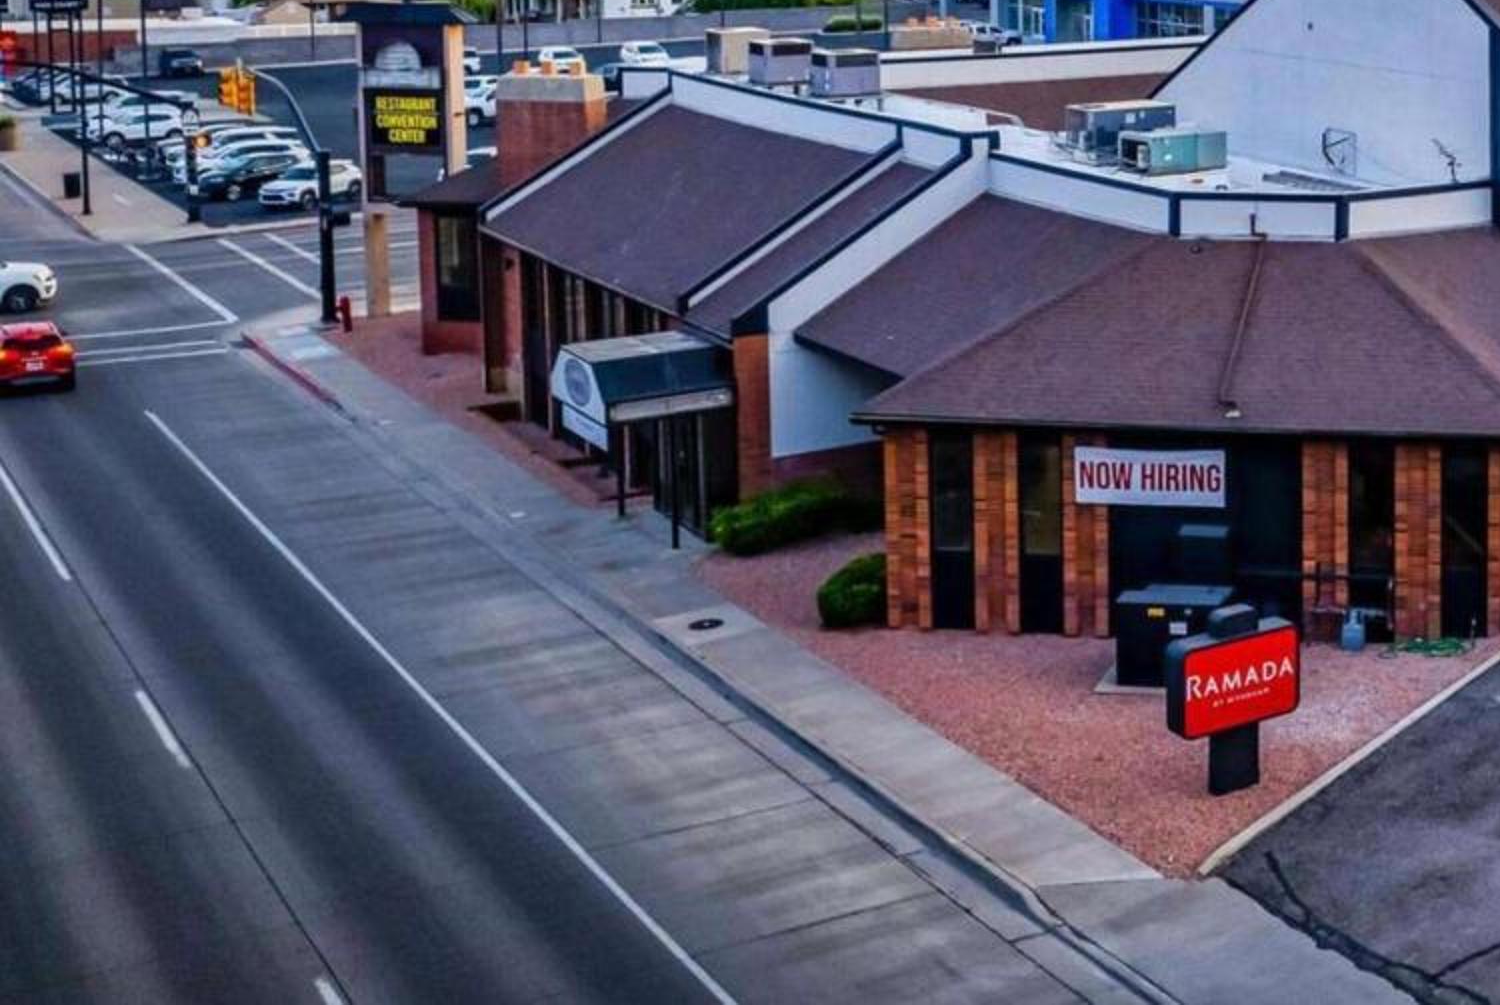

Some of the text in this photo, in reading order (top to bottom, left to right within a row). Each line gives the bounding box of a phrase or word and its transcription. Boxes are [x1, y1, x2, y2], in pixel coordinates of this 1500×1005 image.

[375, 96, 437, 111] RESTAURANT
[375, 114, 438, 129] CONVENTION
[388, 128, 426, 144] CENTER
[1079, 461, 1221, 493] NOW HIRING
[1186, 656, 1294, 702] RAMADA
